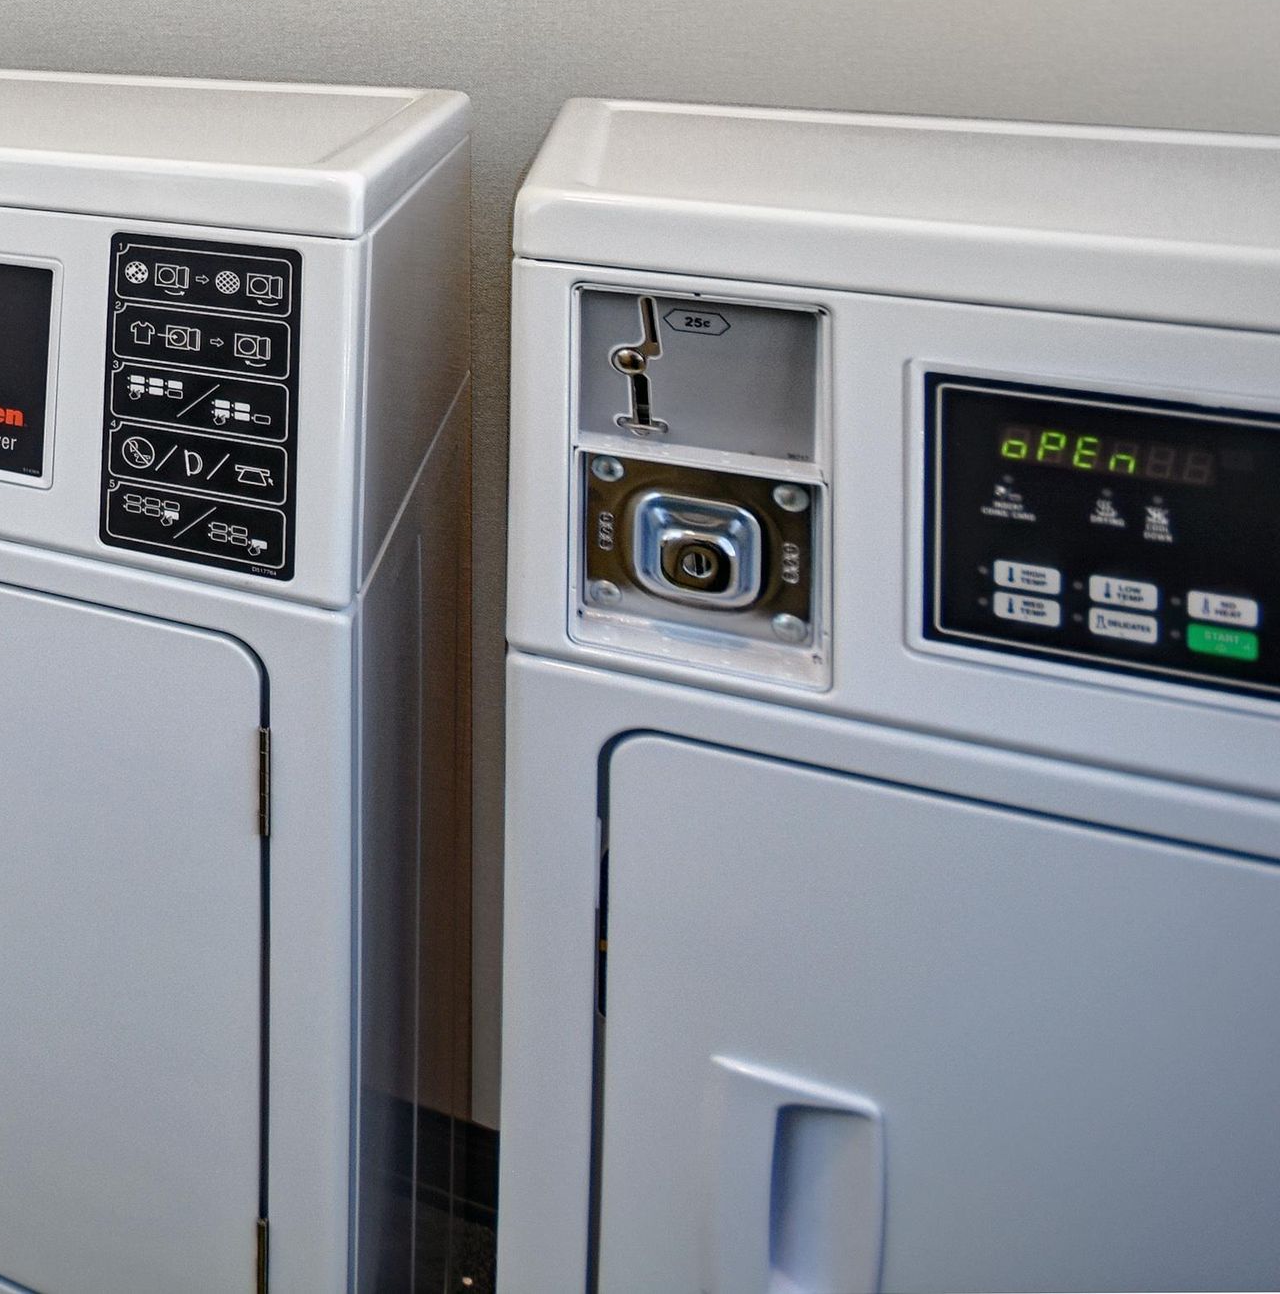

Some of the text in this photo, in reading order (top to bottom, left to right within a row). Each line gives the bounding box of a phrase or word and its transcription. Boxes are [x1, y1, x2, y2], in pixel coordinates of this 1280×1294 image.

[115, 301, 121, 310] 2
[113, 360, 119, 369] 3
[110, 419, 117, 428] 4
[109, 479, 116, 488] 5
[1118, 584, 1142, 595] LOW
